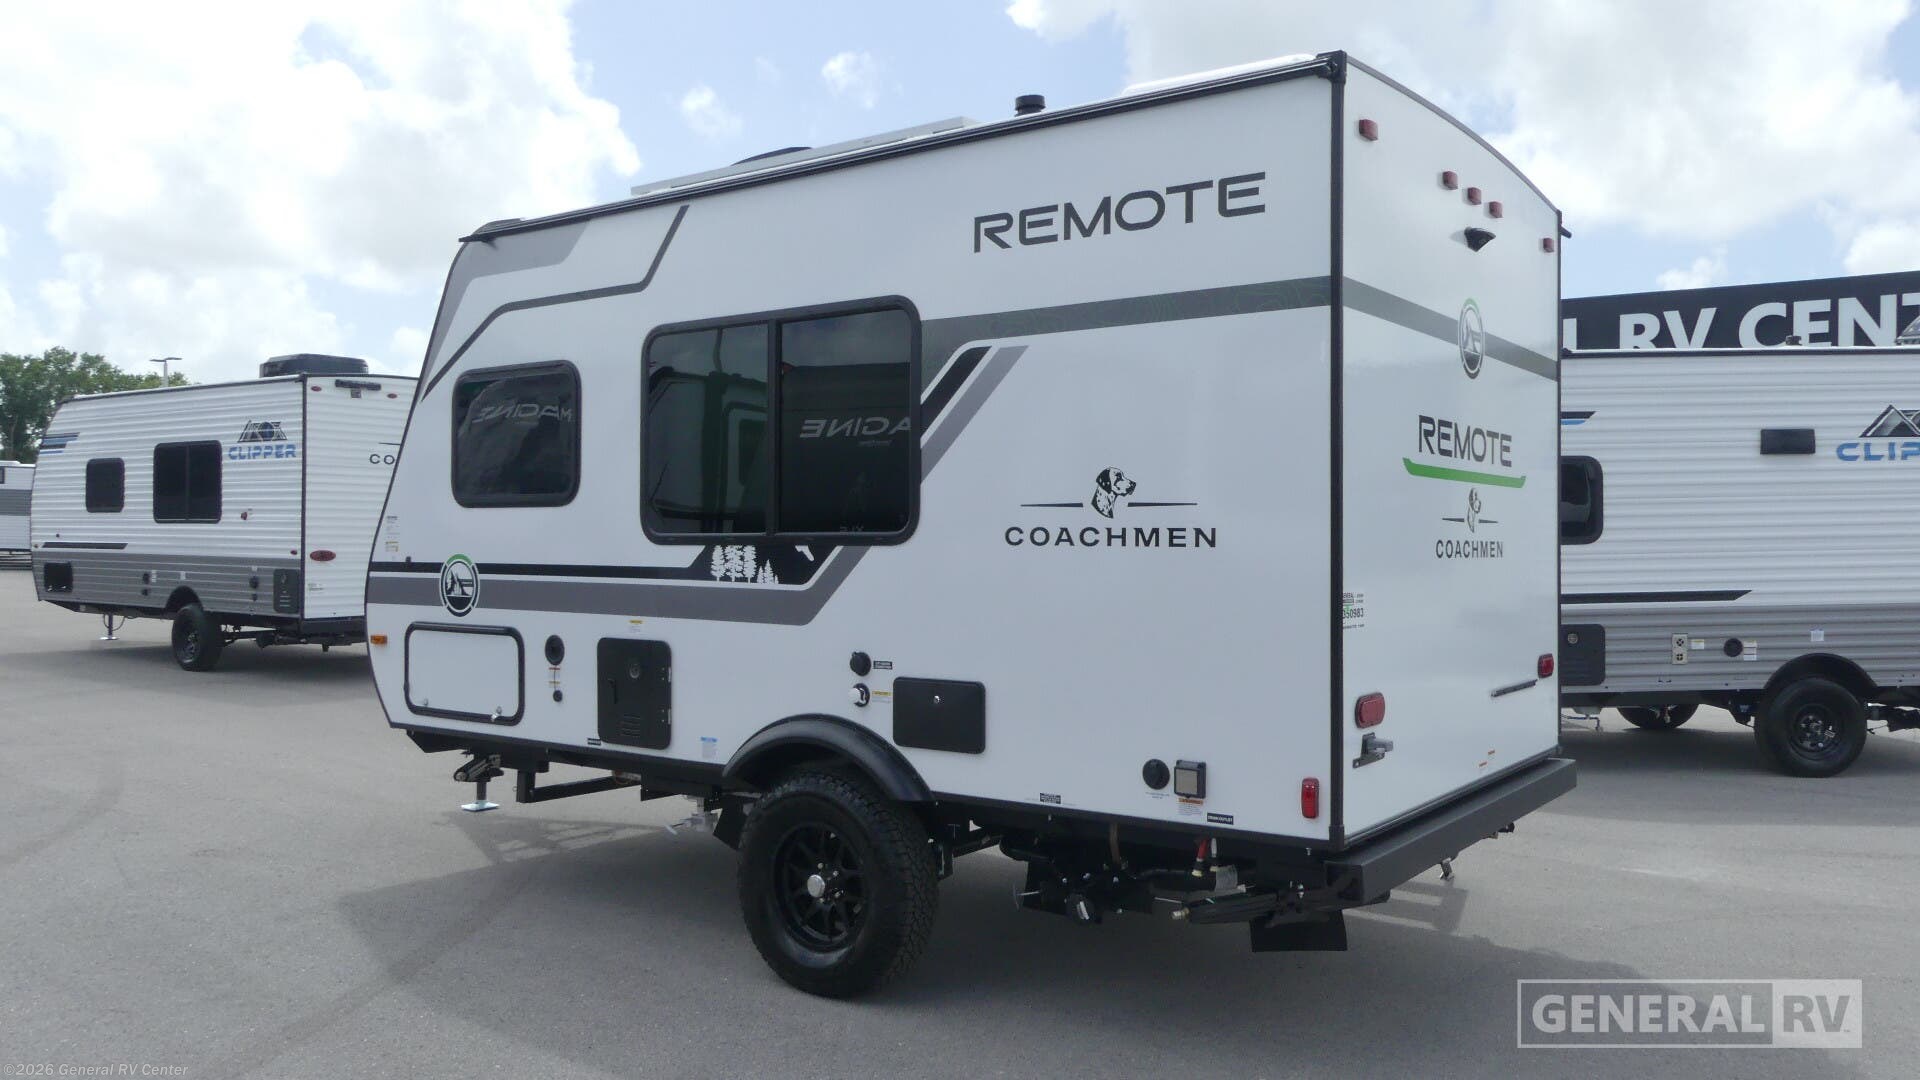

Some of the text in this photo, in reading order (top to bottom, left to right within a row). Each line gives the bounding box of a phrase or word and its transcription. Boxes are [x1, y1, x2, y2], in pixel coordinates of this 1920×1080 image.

[973, 171, 1266, 253] REMOTE
[1619, 307, 1717, 349] RV
[228, 444, 297, 461] CLIPPER
[1418, 414, 1513, 468] REMOTE
[1004, 526, 1217, 548] COACHMEN
[1435, 539, 1504, 559] COACHMEN
